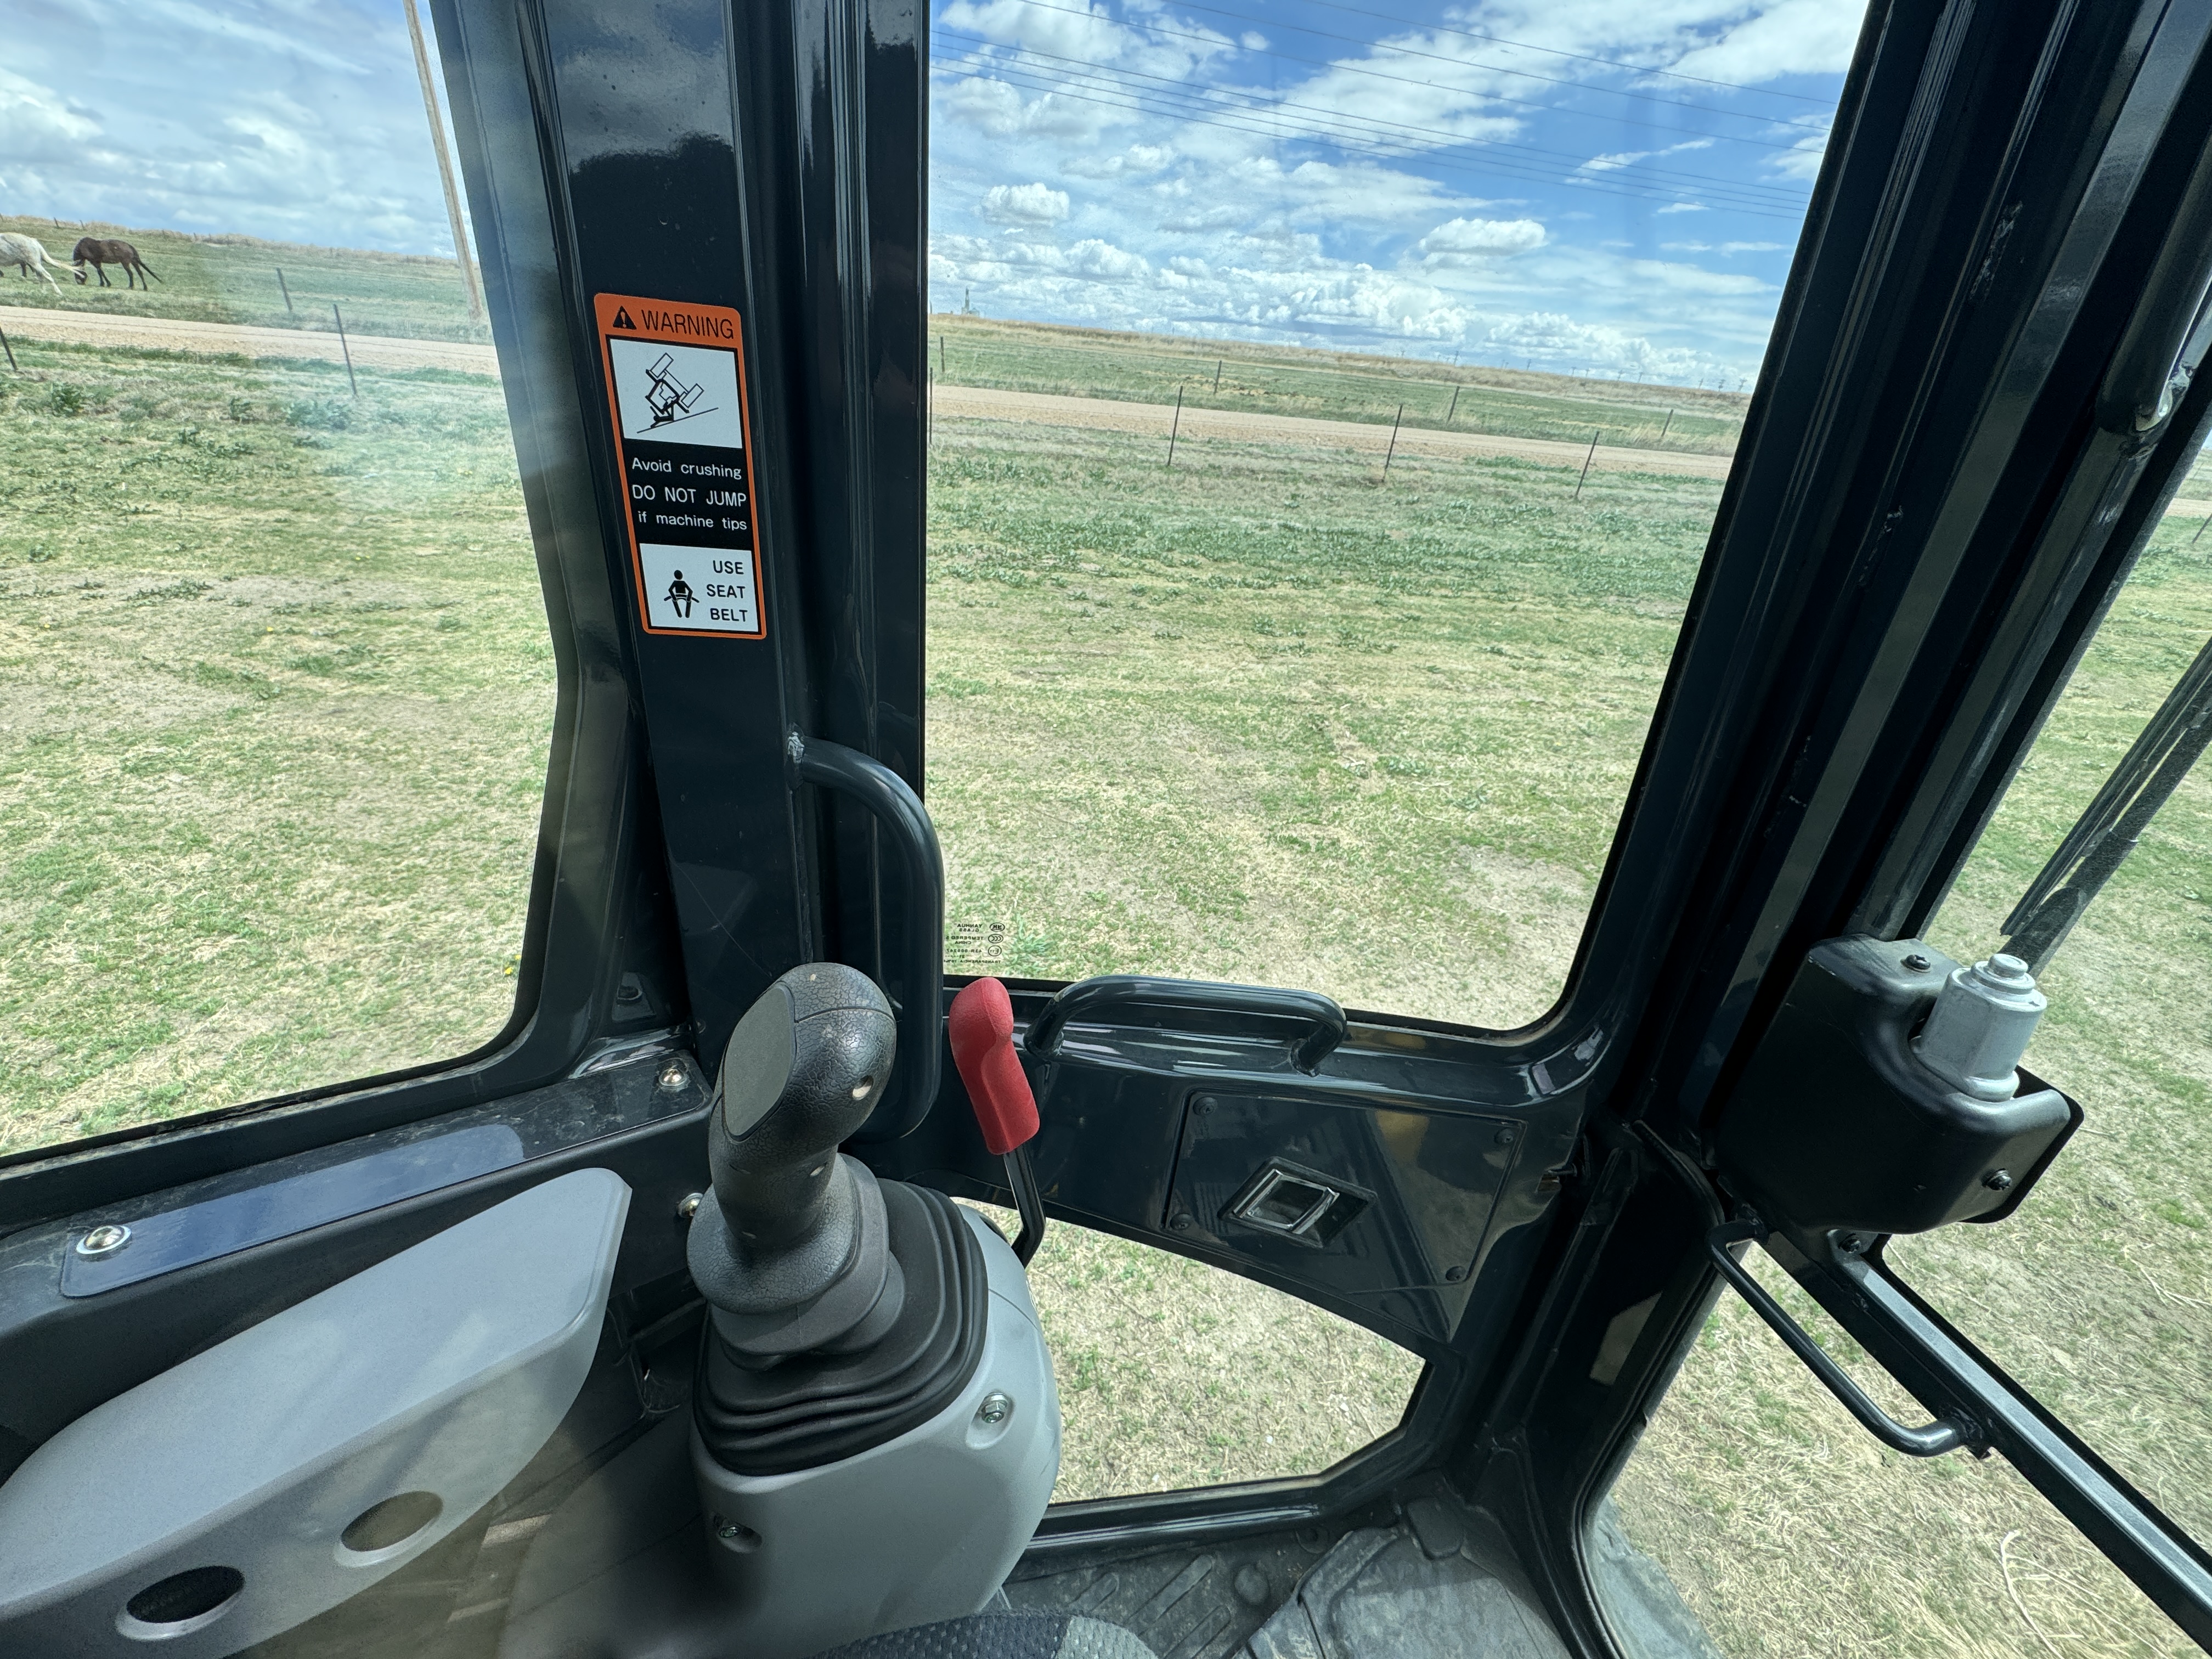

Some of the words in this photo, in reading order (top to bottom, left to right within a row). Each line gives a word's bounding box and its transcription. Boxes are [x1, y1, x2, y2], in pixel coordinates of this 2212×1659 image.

[641, 309, 734, 340] WARNING
[631, 456, 672, 473] Avoid
[680, 463, 742, 480] crushing
[631, 484, 656, 501] DO
[664, 487, 696, 504] NOT
[706, 490, 747, 507] JUMP
[637, 511, 648, 524] if
[656, 512, 714, 528] machine
[722, 516, 747, 531] tips
[713, 560, 744, 575] USE
[707, 584, 746, 599] SEAT
[710, 607, 748, 623] BELT
